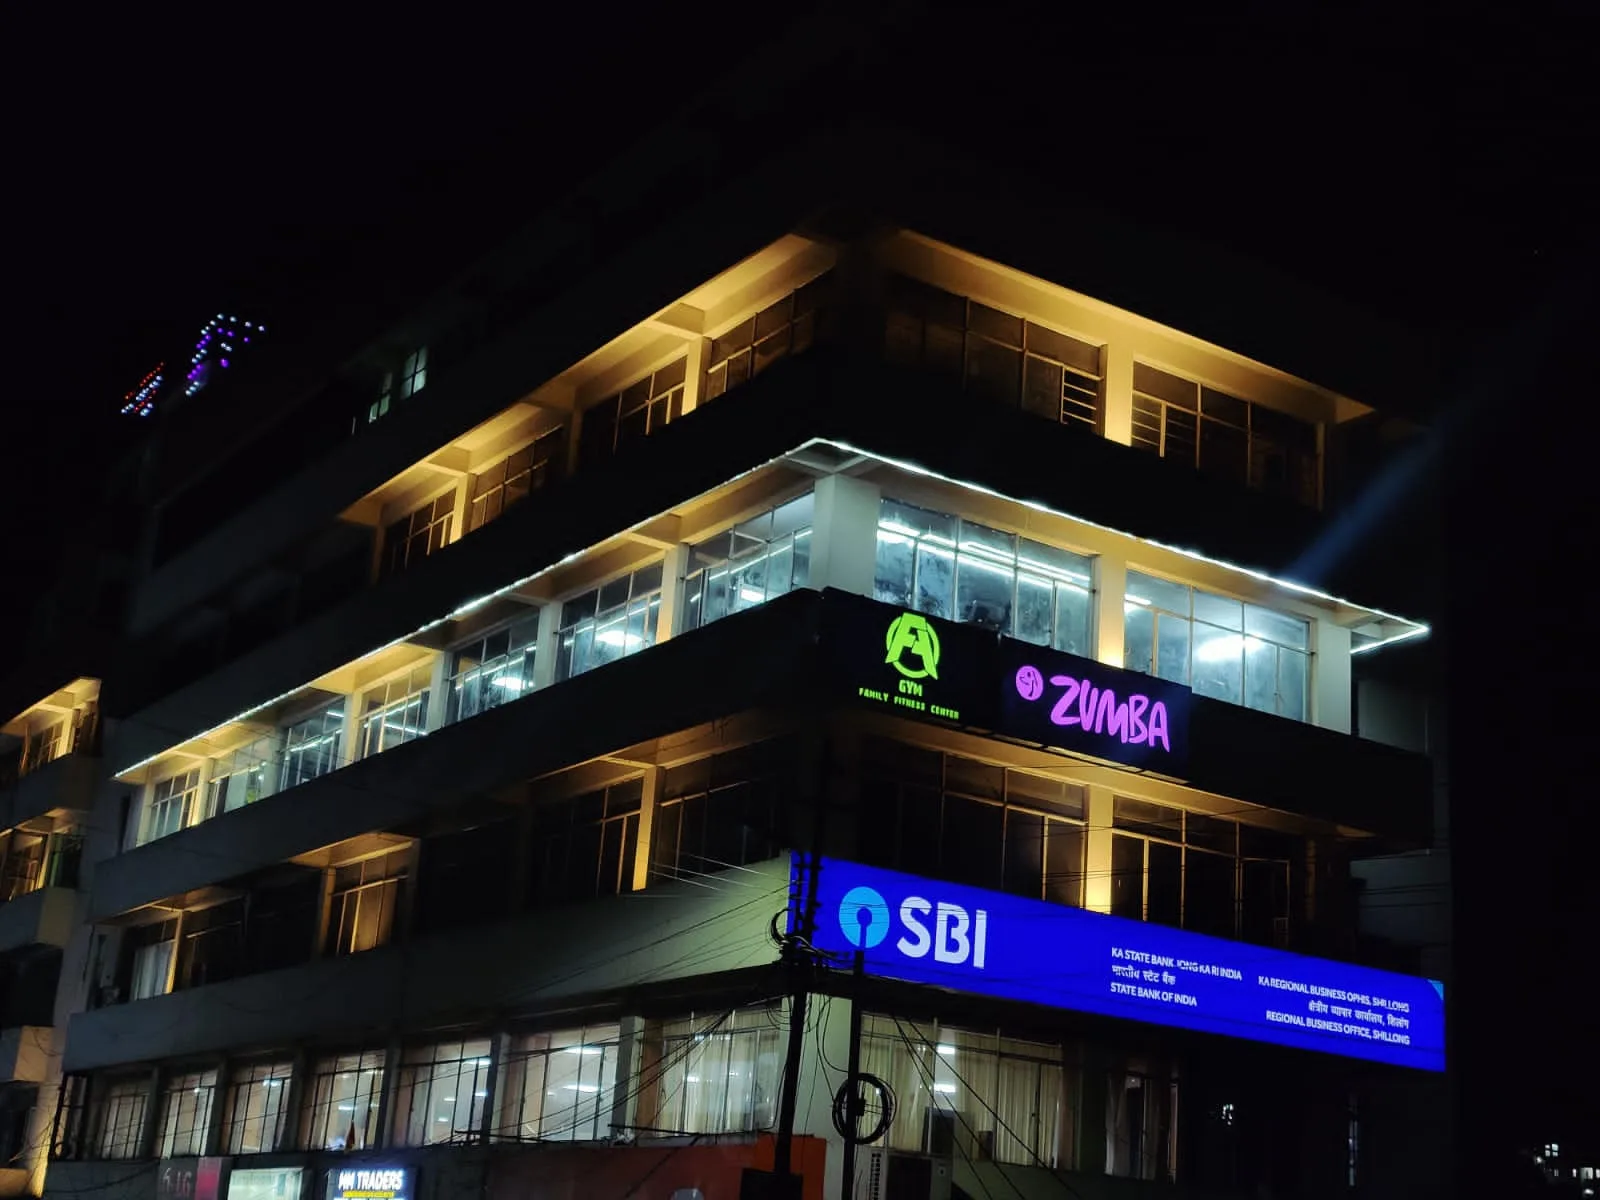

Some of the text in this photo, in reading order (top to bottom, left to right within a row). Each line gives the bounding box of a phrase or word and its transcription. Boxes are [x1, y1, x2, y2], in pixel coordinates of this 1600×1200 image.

[858, 687, 960, 720] FAMILY FITNESS CENTER
[898, 679, 923, 697] GYM
[1049, 675, 1170, 753] ZUMBA
[896, 896, 988, 970] SBI
[1111, 947, 1124, 959] KA
[1124, 950, 1151, 964] STATE
[1151, 954, 1175, 968] BANK
[1199, 963, 1211, 975] KA
[1211, 966, 1219, 977] RI
[1219, 967, 1243, 981] INDIA
[1111, 965, 1176, 986] भारतीय स्टेट बैंक
[1110, 982, 1198, 1008] STATE BANK OF INDIA
[1258, 975, 1270, 987] KA
[1270, 977, 1310, 995] REGIONAL
[1310, 984, 1347, 1001] BUSINESS
[1372, 997, 1410, 1014] SHILLONG
[1266, 1010, 1411, 1046] REGIONAL BUSINESS OFFICE, SHILLONG
[356, 1169, 403, 1190] TRADERS
